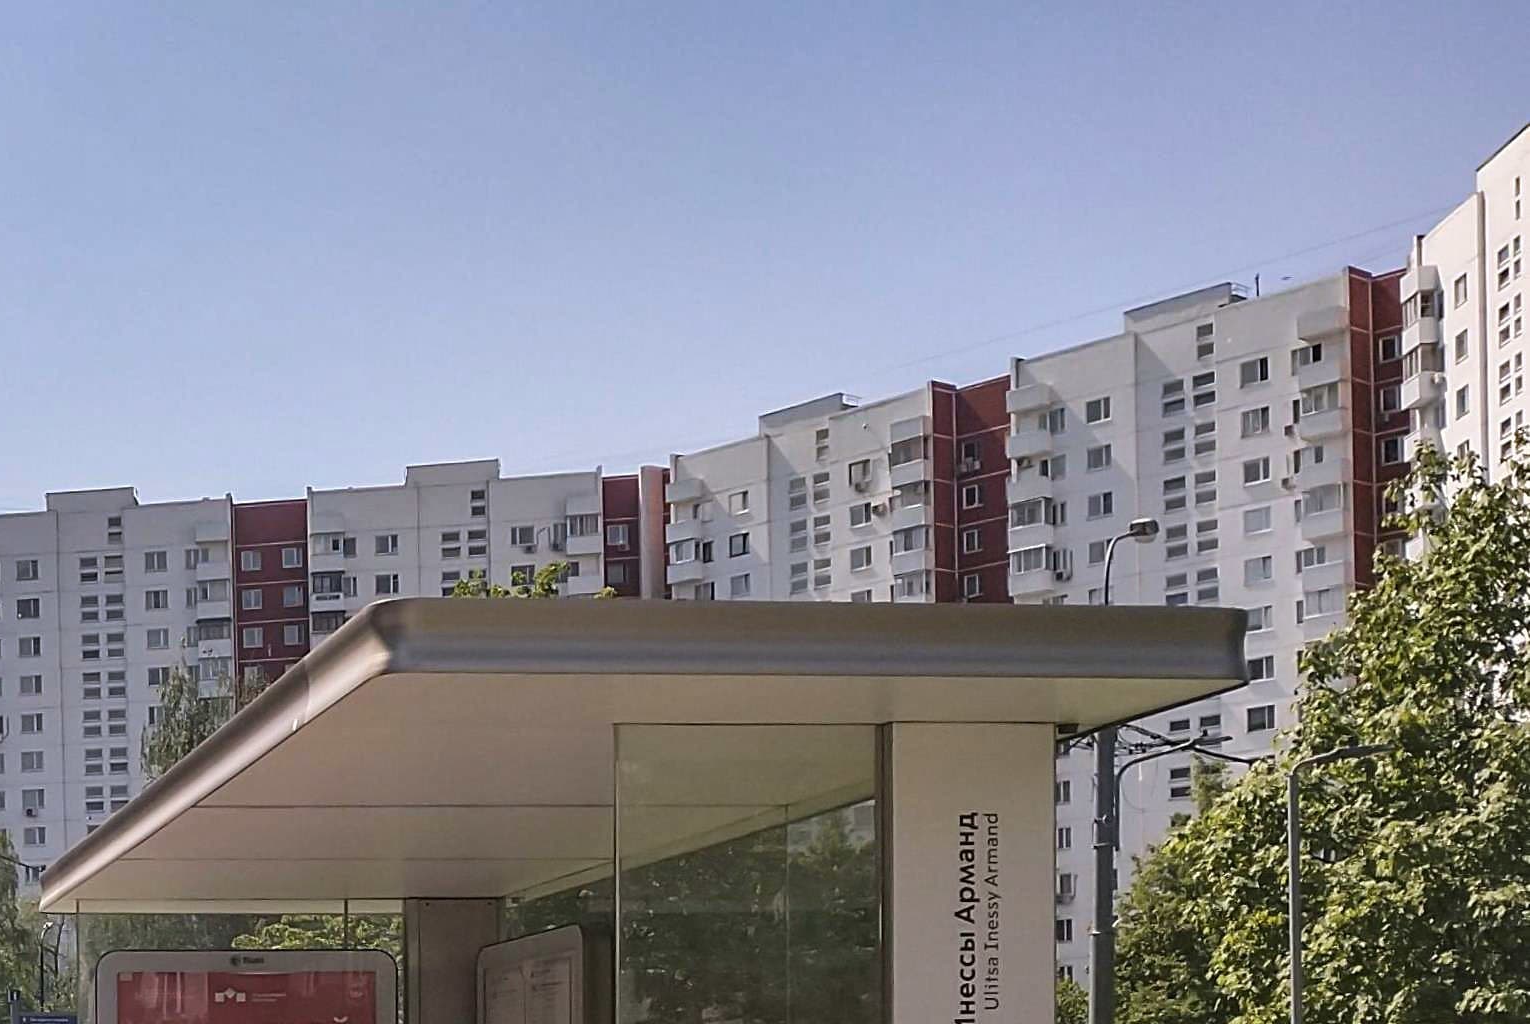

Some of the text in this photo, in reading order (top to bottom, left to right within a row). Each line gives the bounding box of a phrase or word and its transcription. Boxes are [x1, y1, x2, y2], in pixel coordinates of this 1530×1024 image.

[954, 812, 980, 924] Арманд
[984, 812, 1002, 1011] Ulitsa Inessy Armand
